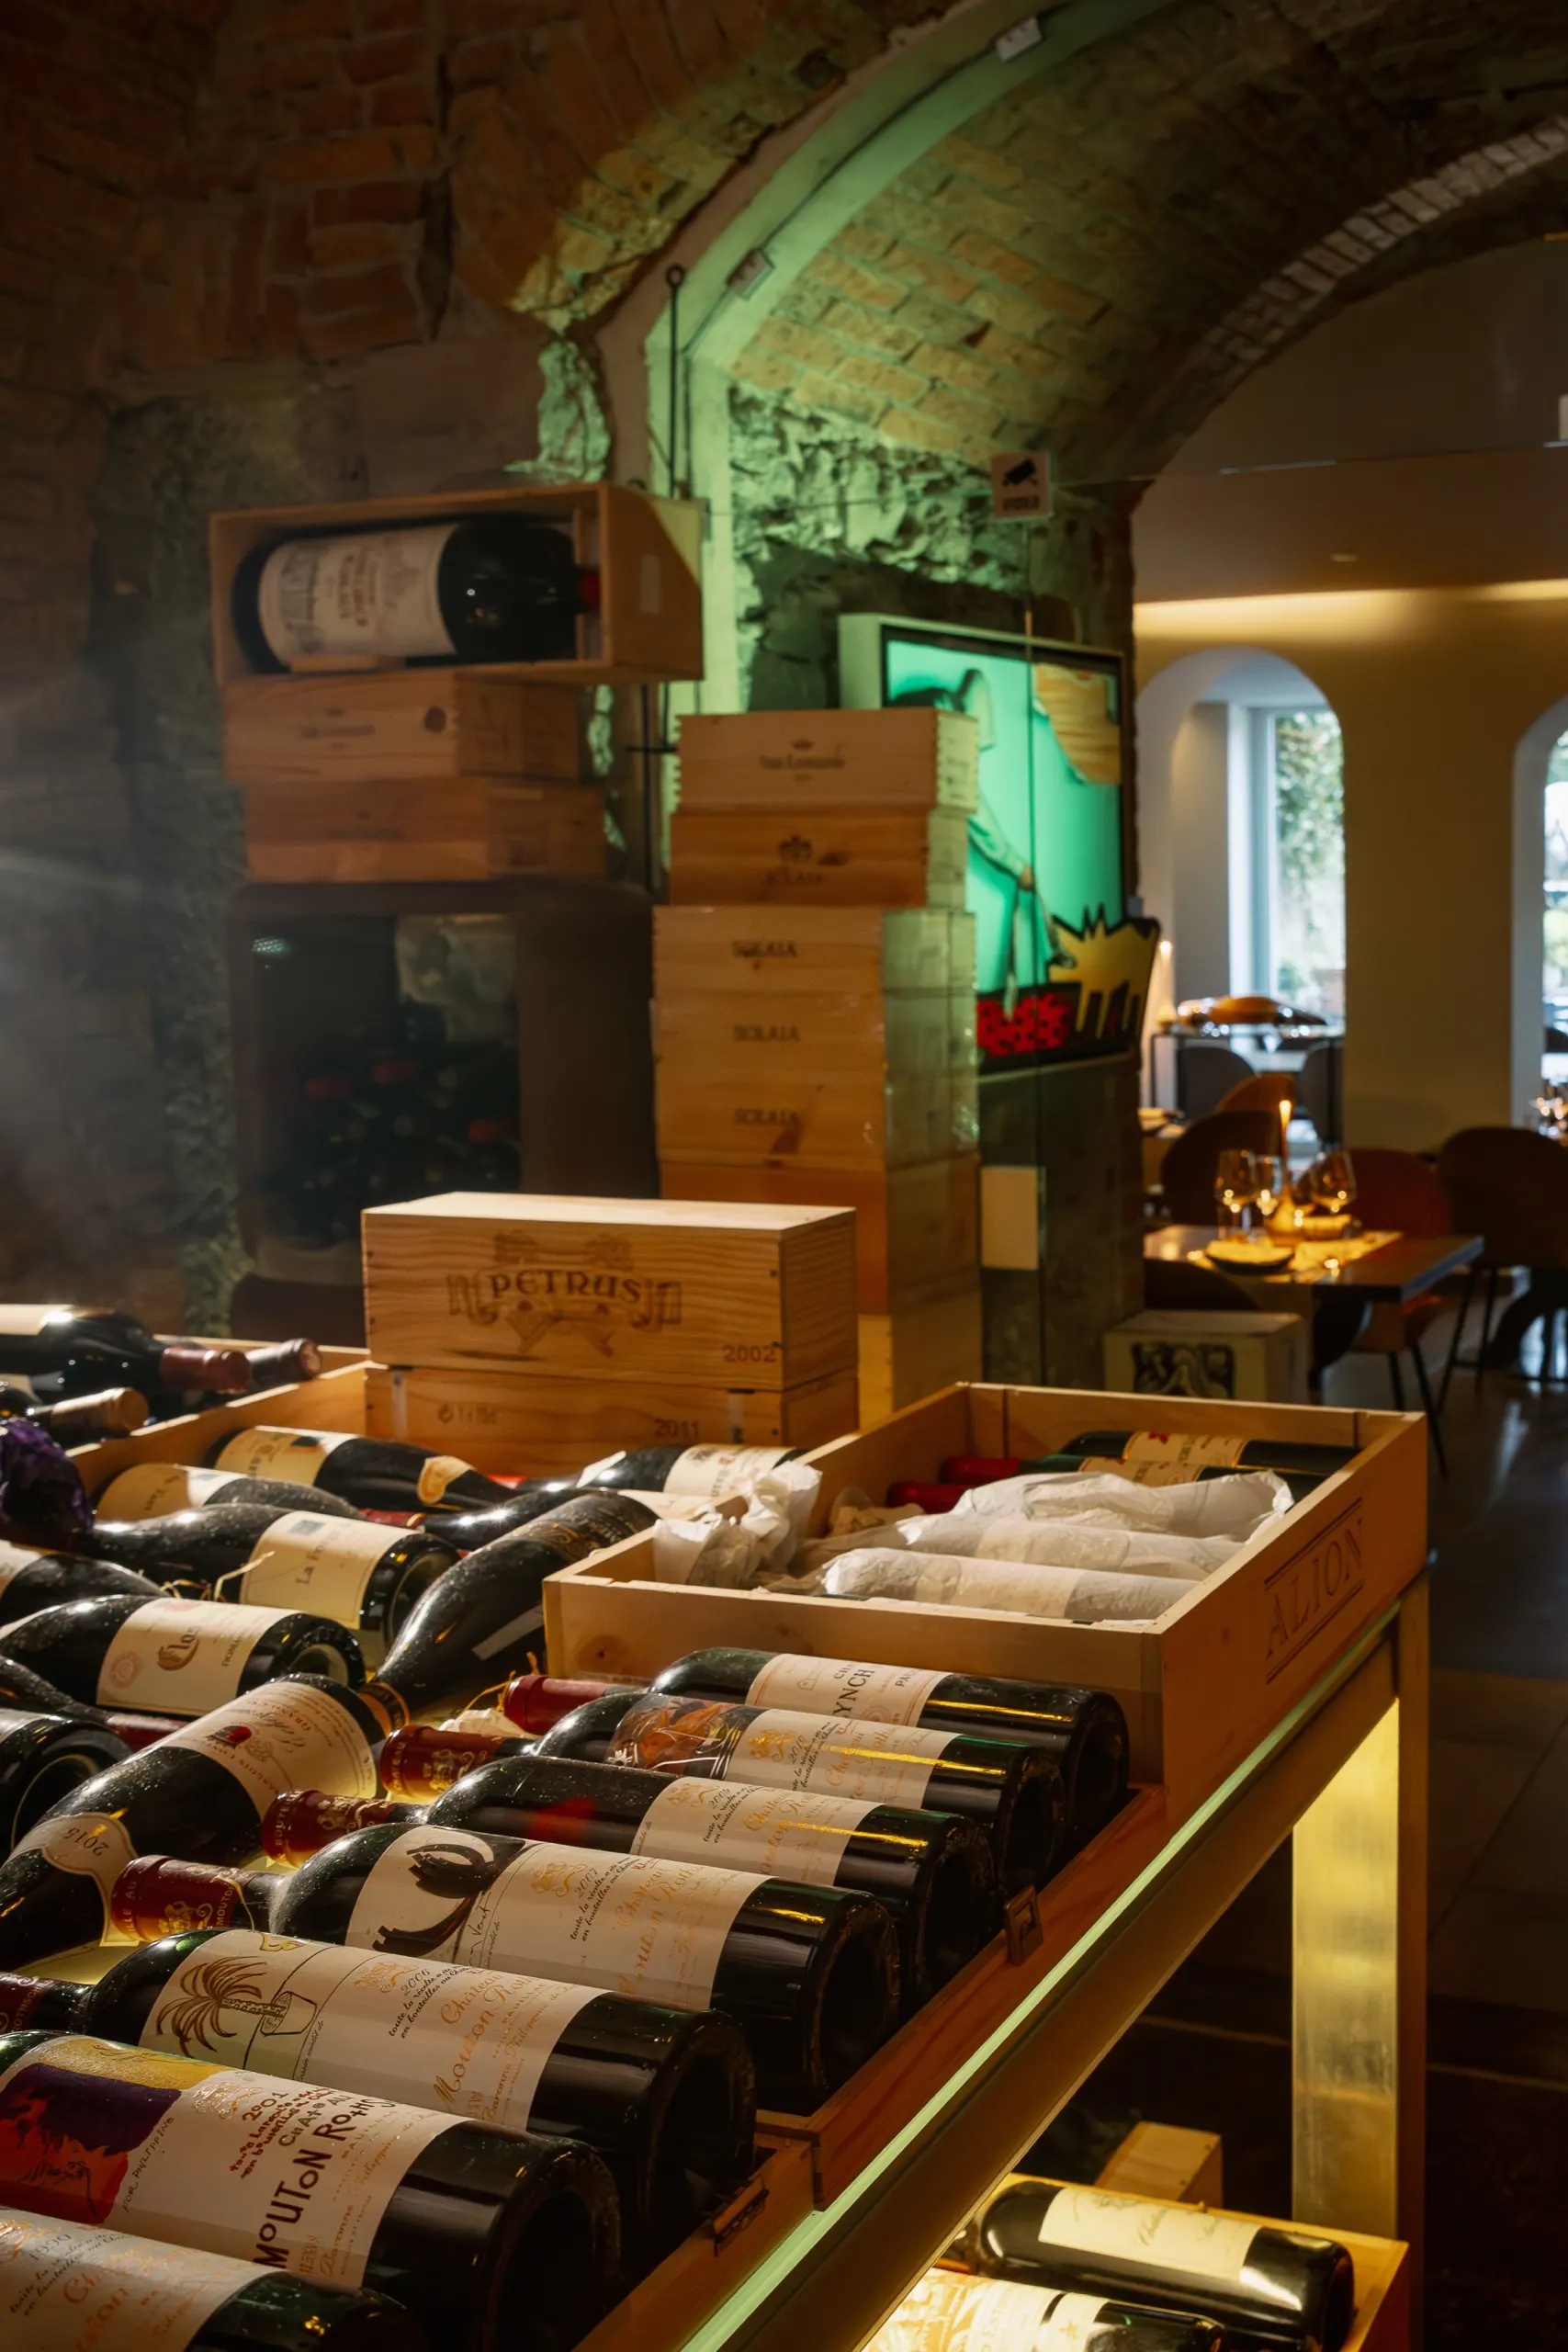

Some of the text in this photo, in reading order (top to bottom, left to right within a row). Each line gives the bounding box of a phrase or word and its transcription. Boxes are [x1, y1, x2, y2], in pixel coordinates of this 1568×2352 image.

[489, 1269, 642, 1305] PETRUS
[723, 1344, 776, 1363] 2002
[654, 1419, 700, 1439] 2011
[1266, 1517, 1363, 1660] ALION
[832, 1668, 875, 1717] YNCH
[788, 1735, 807, 1764] 2010
[713, 1813, 722, 1821] la
[64, 1826, 109, 1856] 2015
[574, 1867, 598, 1899] 2007
[584, 1884, 611, 1927] bouteilles
[570, 1916, 584, 1940] toute
[579, 1903, 589, 1914] la
[581, 1929, 591, 1942] en
[400, 1969, 431, 1996] 2006
[388, 2012, 407, 2037] toute
[403, 2000, 414, 2010] la
[400, 2026, 411, 2039] en
[407, 1984, 441, 2023] bouteilles
[433, 2009, 495, 2110] Mouton
[242, 2092, 289, 2121] 2001
[122, 2182, 139, 2213] FOR
